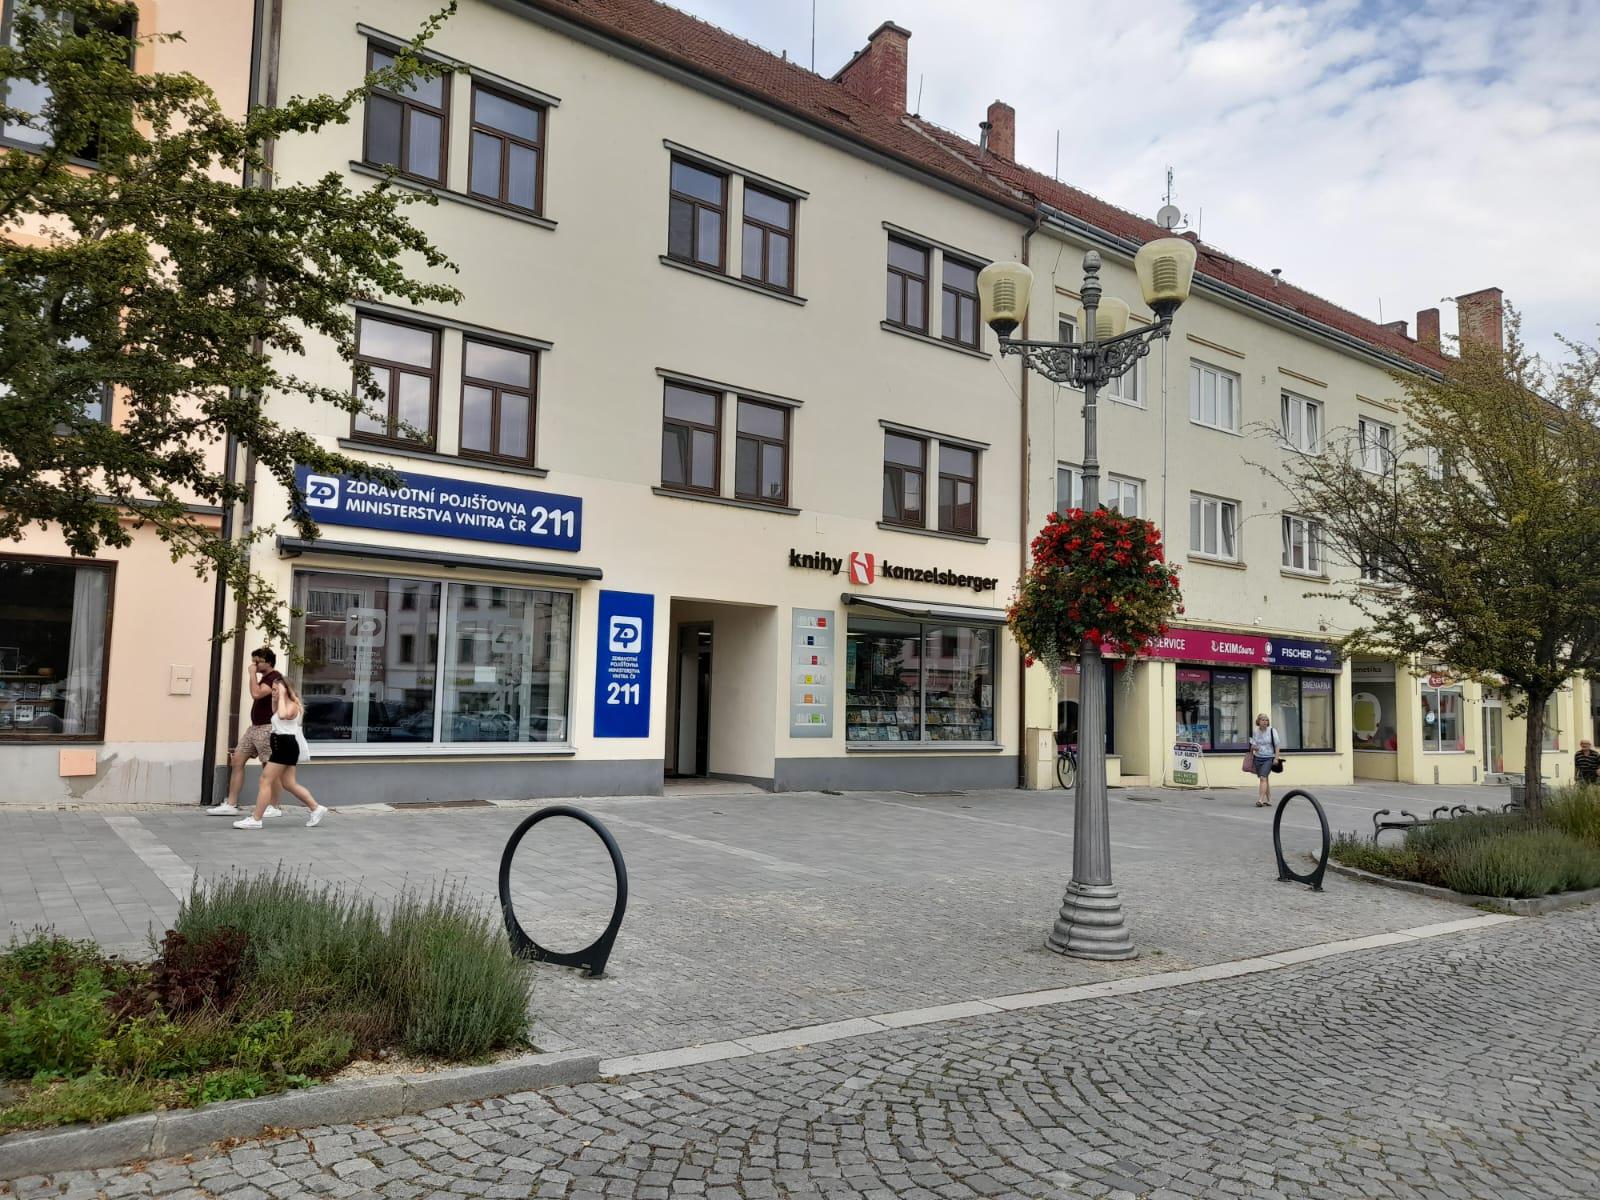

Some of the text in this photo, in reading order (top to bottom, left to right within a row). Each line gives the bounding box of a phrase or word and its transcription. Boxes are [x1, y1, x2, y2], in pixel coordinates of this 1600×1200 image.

[346, 480, 526, 515] ZDRAVOTNÍ POJIŠŤOVNA
[346, 498, 527, 532] MINISTERSTVA VNITRA ČR
[530, 506, 575, 538] 211
[789, 548, 999, 592] knihy kanzelsberger
[1281, 647, 1312, 659] FISCHER
[606, 682, 640, 705] 211
